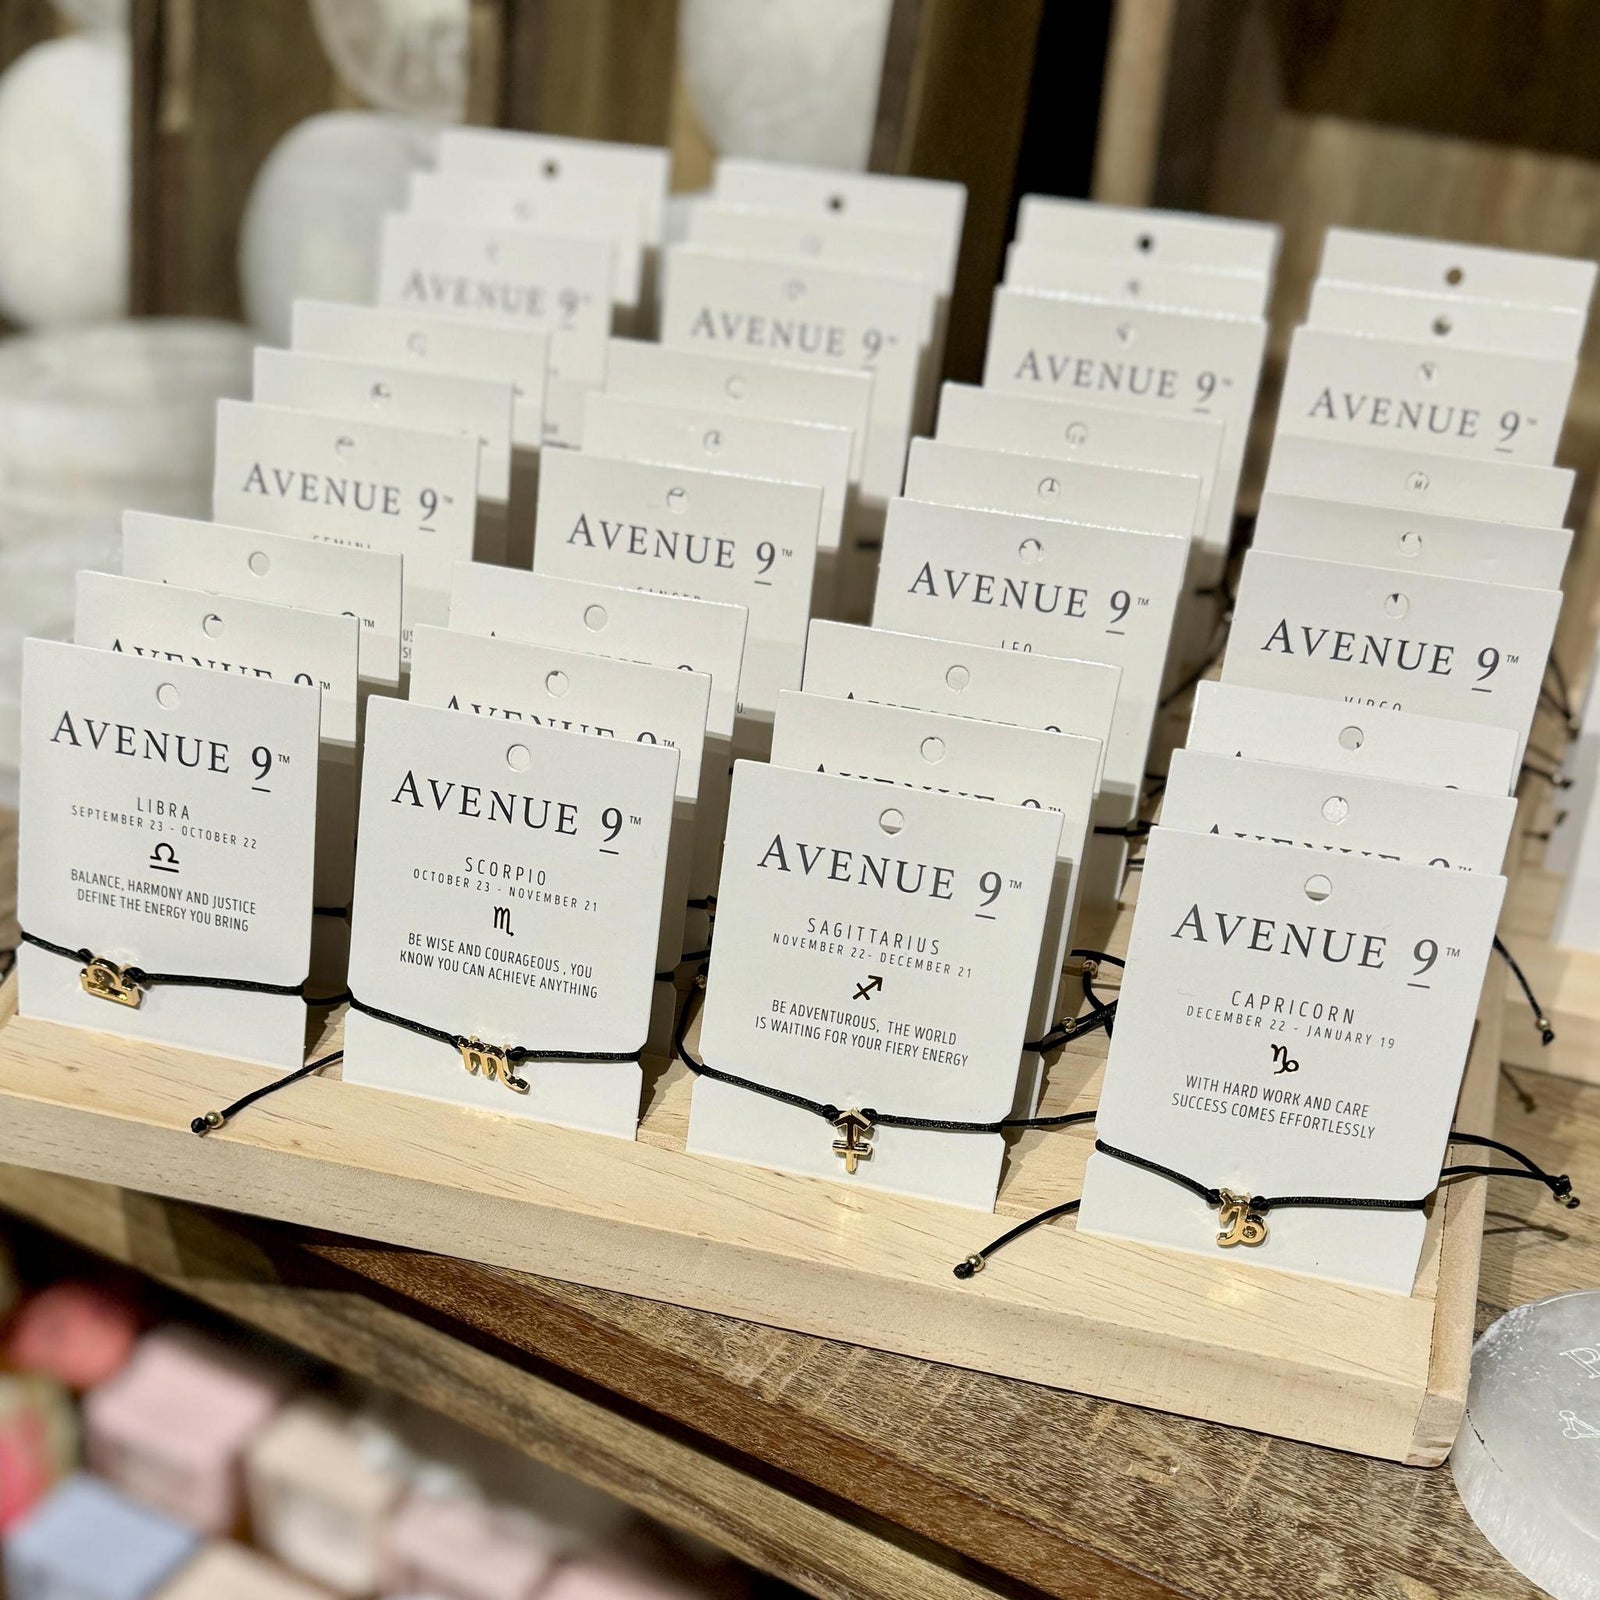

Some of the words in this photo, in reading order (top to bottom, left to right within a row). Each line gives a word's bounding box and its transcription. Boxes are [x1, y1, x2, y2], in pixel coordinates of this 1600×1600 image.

[689, 306, 847, 356] AVENUE
[1014, 349, 1179, 398] AVENUE
[1307, 386, 1480, 438] AVENUE
[243, 462, 400, 516] AVENUE
[566, 513, 735, 569] AVENUE
[907, 561, 1088, 618] AVENUE
[1260, 618, 1454, 676] AVENUE
[50, 710, 230, 774] AVENUE
[137, 797, 189, 820] LIBRA
[391, 770, 578, 835] AVENUE
[72, 805, 143, 827] SEPTEMBER
[150, 819, 163, 831] 23
[182, 825, 236, 845] OCTOBER
[243, 837, 256, 849] 22
[413, 868, 470, 888] OCTOBER
[476, 880, 490, 892] 23
[509, 886, 577, 908] NOVEMBER
[584, 900, 596, 912] 21
[465, 857, 546, 886] SCORPIO
[757, 834, 954, 900] AVENUE
[71, 869, 124, 891] BALANCE,
[128, 879, 183, 900] HARMONY
[186, 890, 209, 905] AND
[212, 896, 256, 915] JUSTICE
[78, 888, 116, 907] DEFINE
[120, 896, 141, 912] THE
[145, 901, 187, 919] ENERGY
[190, 909, 211, 925] YOU
[215, 914, 248, 932] BRING
[408, 932, 422, 947] BE
[426, 936, 455, 953] WISE
[457, 942, 481, 957] AND
[570, 963, 592, 979] YOU
[773, 933, 844, 955] NOVEMBER
[880, 952, 950, 974] DECEMBER
[958, 967, 971, 978] 21
[807, 917, 939, 955] SAGITTARIUS
[1170, 903, 1386, 969] AVENUE
[400, 950, 434, 967] KNOW
[438, 956, 459, 972] YOU
[462, 961, 485, 977] CAN
[488, 967, 536, 987] ACHIEVE
[539, 976, 597, 999] ANYTHING
[772, 999, 787, 1014] BE
[789, 1003, 879, 1033] ADVENTUROUS,
[888, 1021, 911, 1037] THE
[915, 1026, 956, 1045] WORLD
[1187, 1005, 1262, 1027] DECEMBER
[1270, 1019, 1285, 1031] 22
[1306, 1025, 1372, 1045] JANUARY
[1381, 1037, 1394, 1048] 19
[1232, 990, 1354, 1024] CAPRICORN
[755, 1016, 766, 1029] IS
[771, 1018, 821, 1040] WAITING
[824, 1029, 848, 1045] FOR
[851, 1034, 882, 1051] YOUR
[885, 1040, 919, 1057] FIERY
[922, 1047, 968, 1067] ENERGY
[1171, 1093, 1228, 1114] SUCCESS
[1231, 1103, 1276, 1123] COMES
[1279, 1111, 1375, 1139] EFFORTLESSLY
[1186, 1075, 1219, 1092] WITH
[1223, 1081, 1258, 1099] HARD
[1263, 1088, 1301, 1106] WORK
[1303, 1095, 1332, 1111] AND
[1335, 1100, 1369, 1118] CARE
